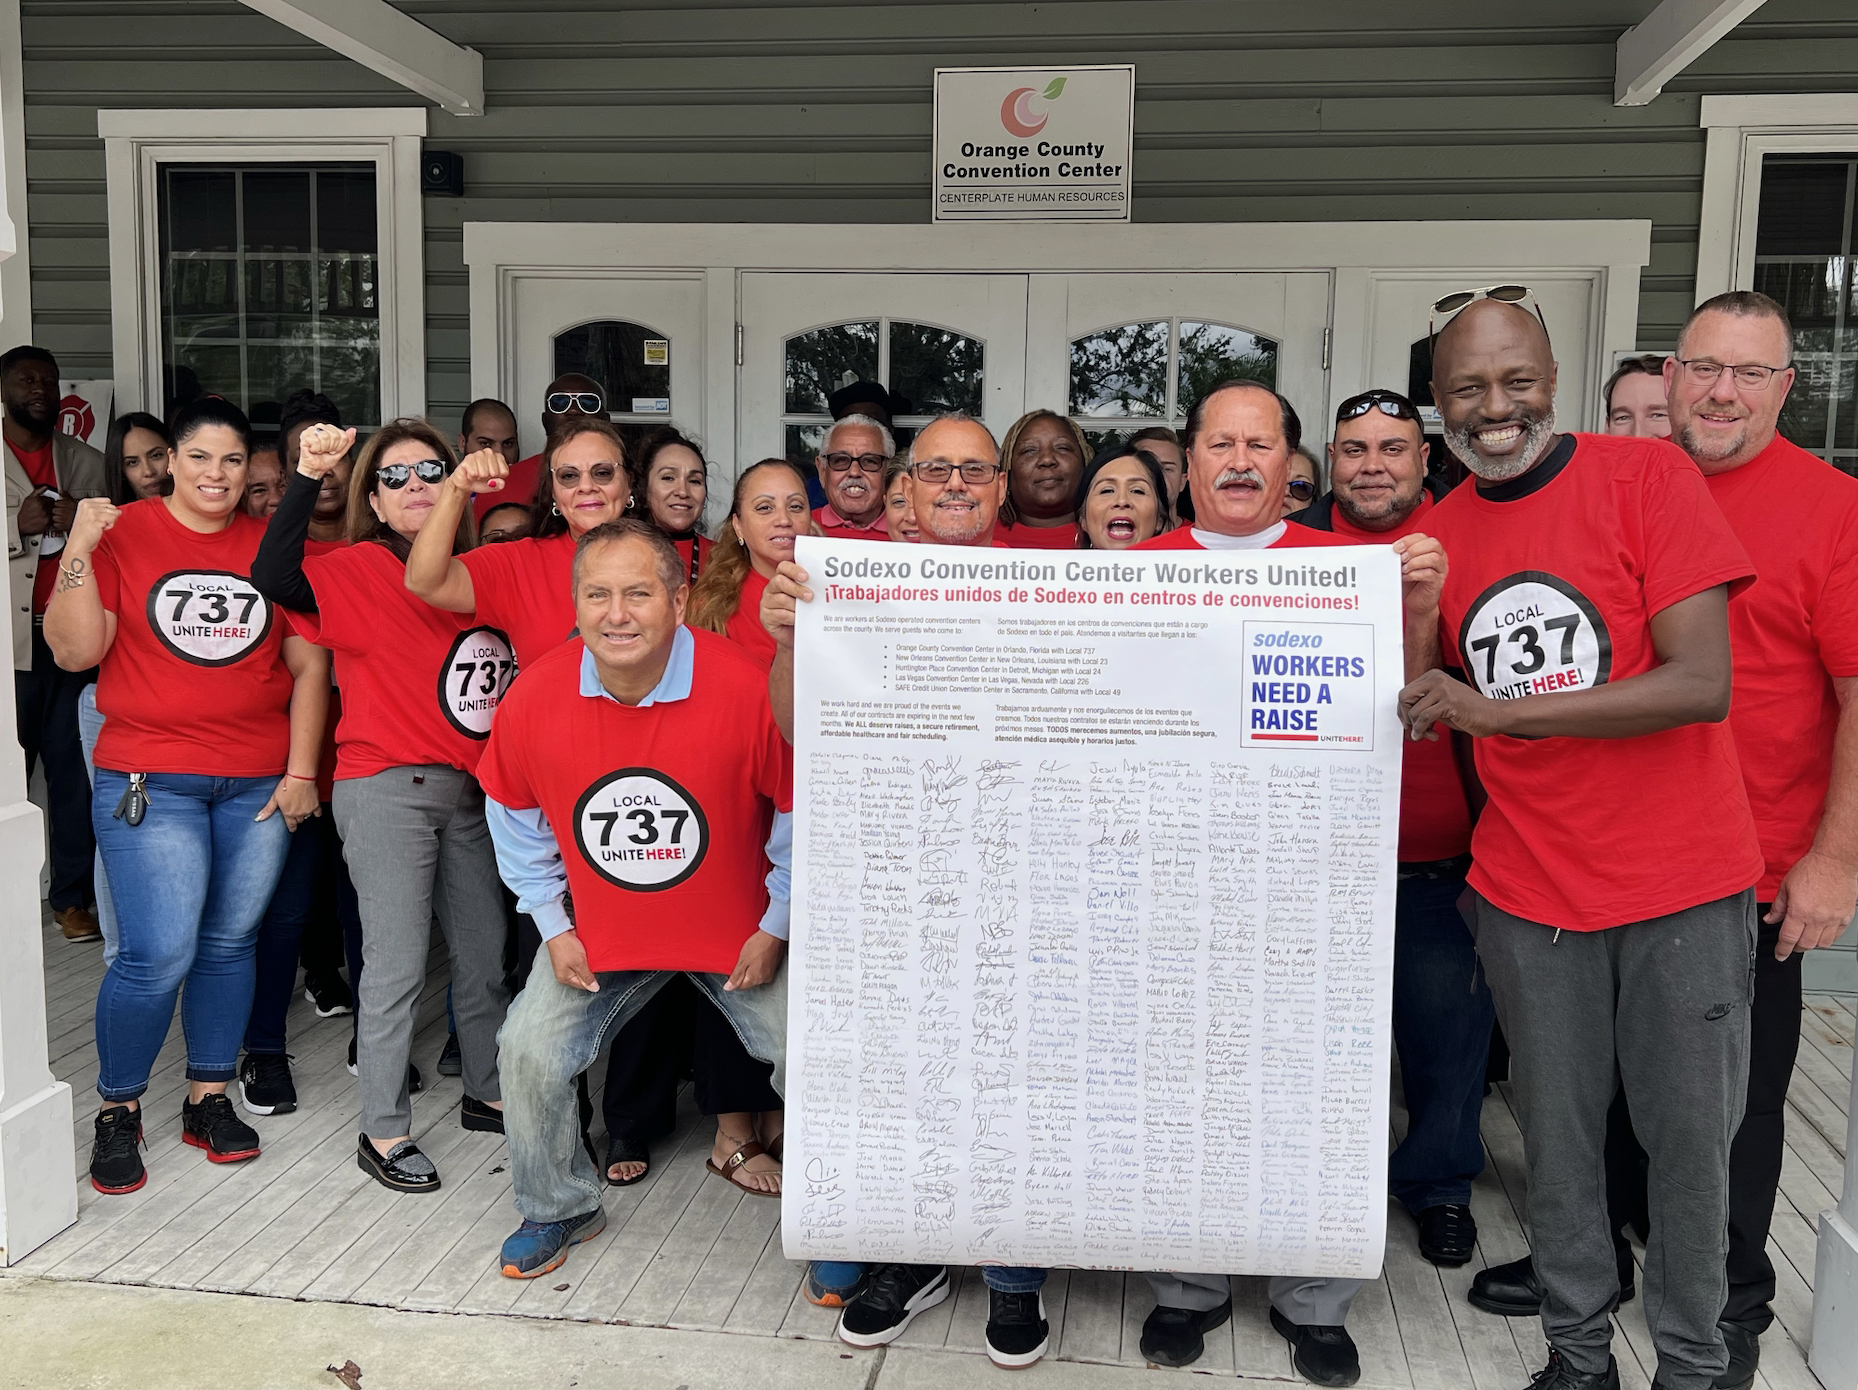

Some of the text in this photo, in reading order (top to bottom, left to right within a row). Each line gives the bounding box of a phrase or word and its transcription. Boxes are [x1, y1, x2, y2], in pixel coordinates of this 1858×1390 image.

[961, 142, 1104, 159] Orange County
[943, 162, 1122, 178] Convention Center
[940, 192, 1125, 203] CENTERPLATE HUMAN RESOURCES
[62, 414, 75, 435] R
[824, 557, 1356, 588] Sodexo Convention Center Workers United!
[189, 583, 233, 592] LOCAL
[824, 584, 1358, 610] ¡Trabajadores unidos de Sodexo en centros de convenciones!
[166, 590, 259, 624] 737
[897, 616, 924, 624] operated
[1494, 604, 1544, 628] LOCAL
[901, 626, 922, 635] guests
[1253, 631, 1323, 648] sodexo
[473, 647, 499, 658] LOCAL
[896, 644, 917, 652] Orange
[918, 644, 939, 652] County
[1471, 613, 1580, 684] 737
[896, 664, 927, 672] Huntington
[1031, 666, 1059, 675] Michigan
[1252, 655, 1365, 677] WORKERS
[456, 660, 511, 696] 737
[906, 674, 924, 683] Vegas
[999, 676, 1020, 684] Vegas,
[1011, 686, 1048, 694] Sacramento,
[1252, 682, 1332, 704] NEED A
[1252, 708, 1318, 730] RAISE
[894, 722, 915, 730] raises,
[944, 723, 980, 732] retirement,
[1108, 727, 1143, 736] aumentos,
[1158, 728, 1191, 737] jubilación
[911, 732, 948, 741] scheduling.
[1048, 736, 1080, 745] asequible
[1114, 738, 1137, 746] justos.
[613, 795, 661, 808] LOCAL
[589, 809, 689, 846] 737
